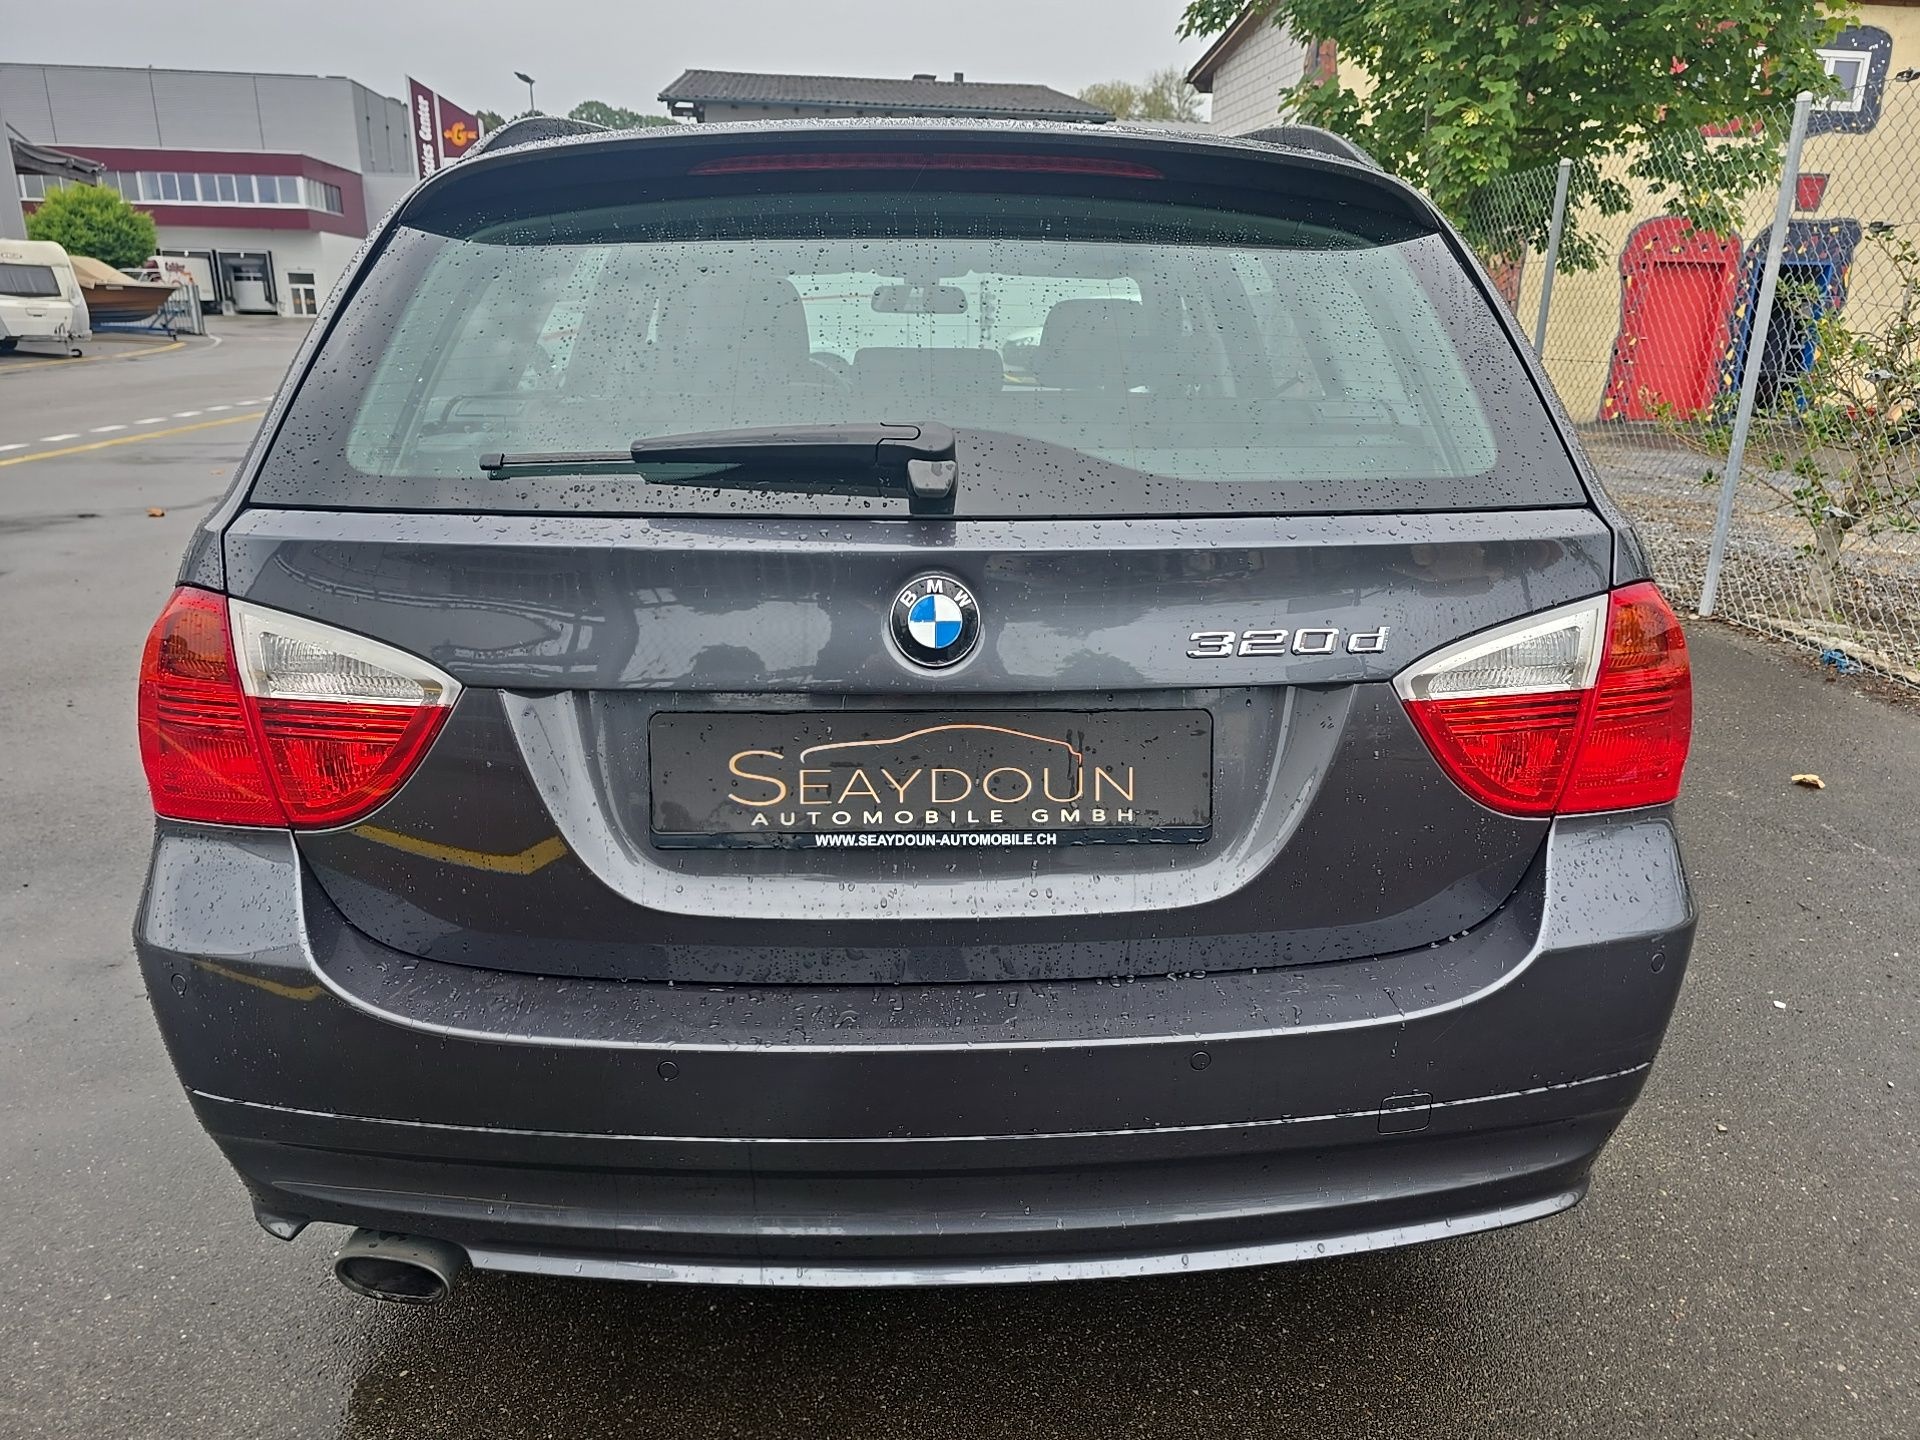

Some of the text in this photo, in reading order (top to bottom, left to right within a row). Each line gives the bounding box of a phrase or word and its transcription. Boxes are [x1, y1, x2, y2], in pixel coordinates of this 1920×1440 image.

[418, 95, 432, 141] Center
[900, 579, 971, 608] BMW
[1187, 626, 1390, 657] 320d
[728, 750, 1133, 806] SEAYDOUN
[751, 808, 1133, 826] AUTOMOBILE GMBH
[815, 833, 1057, 847] WWW.SEAYDOUN-AUTOMOBILE.CH
